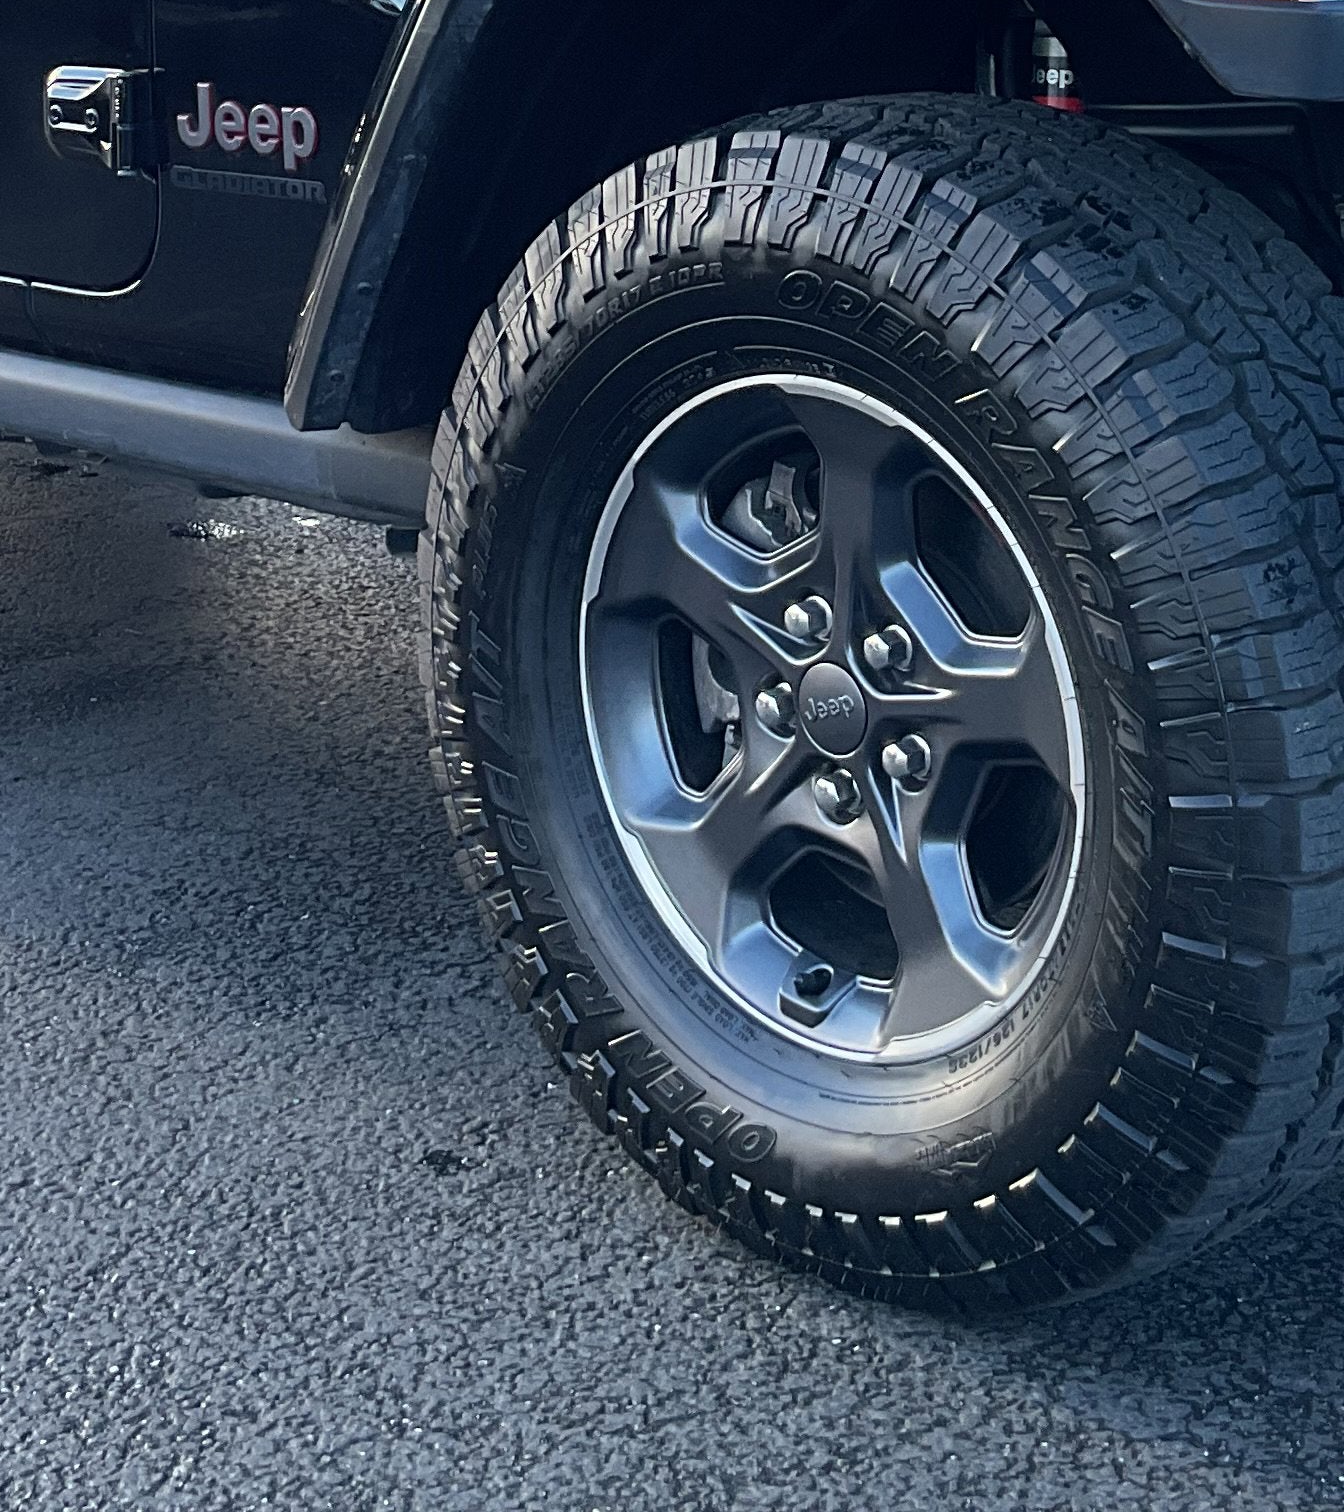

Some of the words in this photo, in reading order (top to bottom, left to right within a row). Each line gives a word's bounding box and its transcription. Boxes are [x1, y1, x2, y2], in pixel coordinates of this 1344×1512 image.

[1032, 68, 1074, 89] eep
[176, 81, 318, 173] Jeep
[171, 165, 327, 204] GLADIATOR
[777, 269, 962, 382] OPEN
[954, 388, 1134, 676] RANGE
[804, 694, 854, 721] Jeep
[482, 760, 625, 1017] RANGE
[607, 1029, 778, 1163] OPEN
